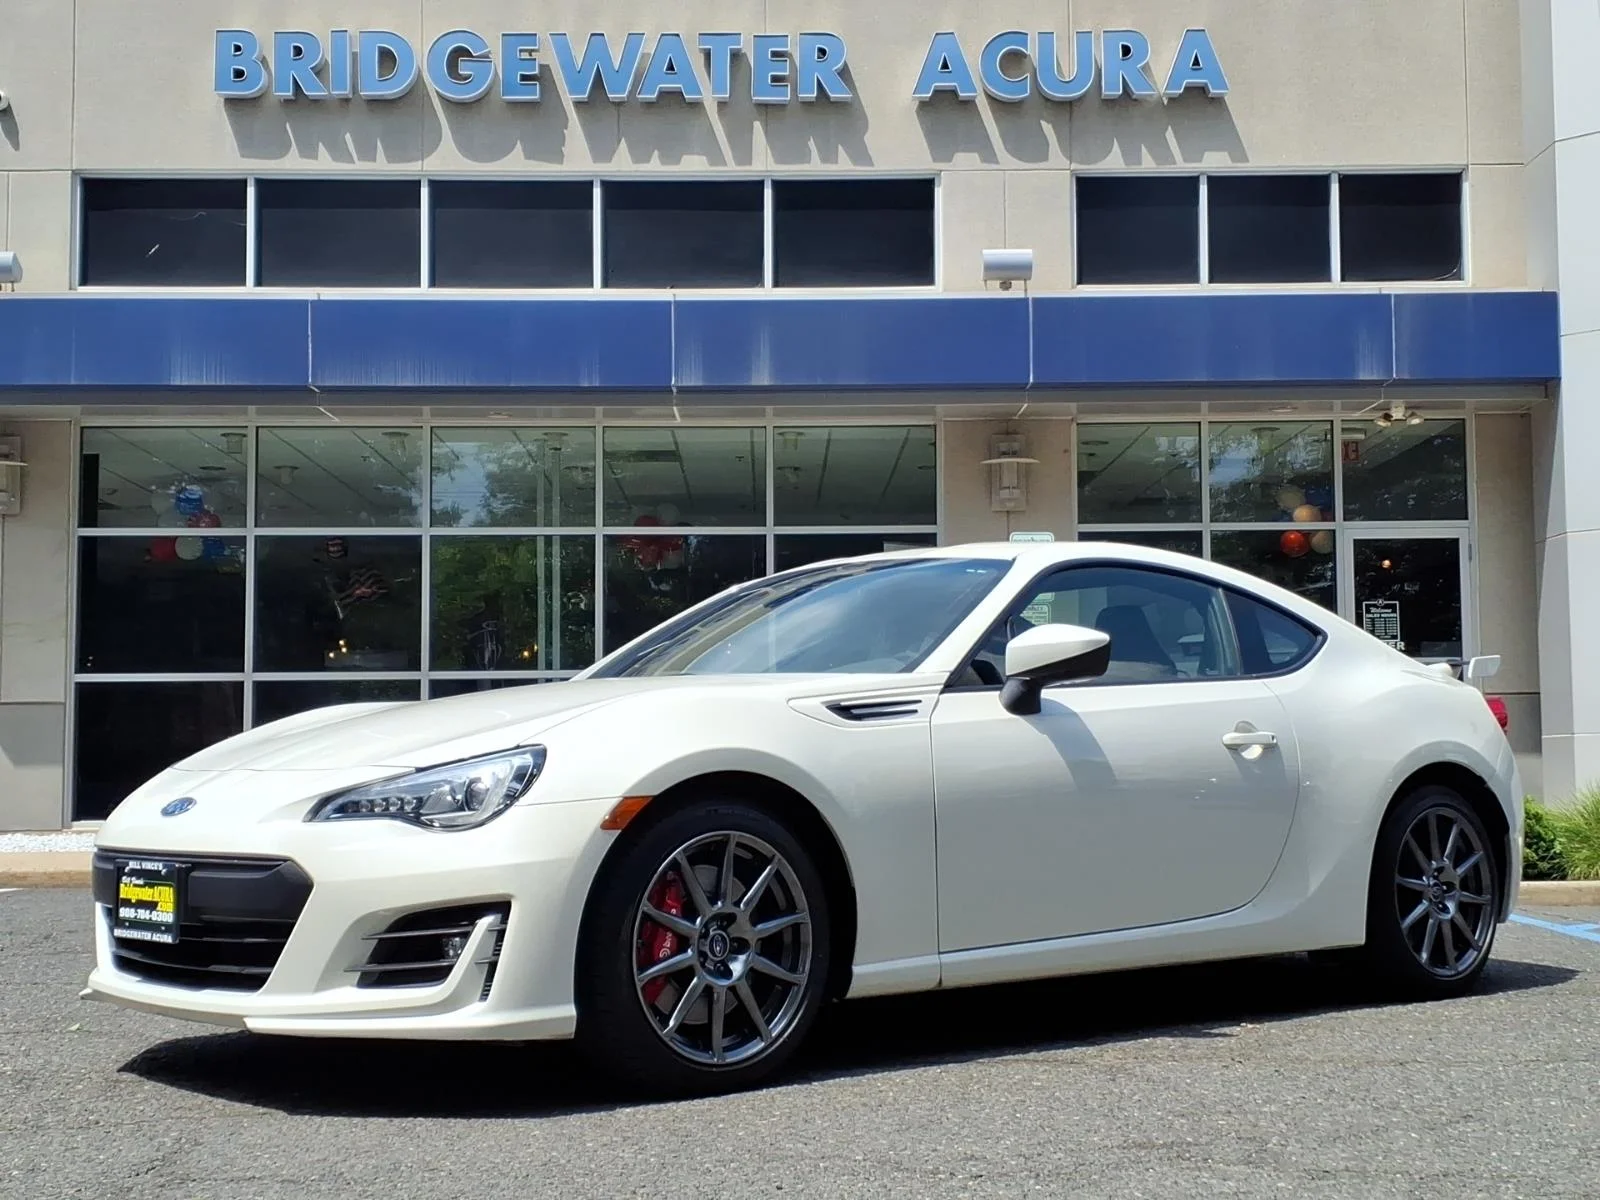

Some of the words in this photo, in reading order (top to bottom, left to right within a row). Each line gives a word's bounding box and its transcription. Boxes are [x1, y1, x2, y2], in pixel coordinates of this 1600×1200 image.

[214, 28, 853, 104] BRIDGEWATER
[912, 28, 1229, 103] ACURA
[152, 933, 173, 943] ACURA
